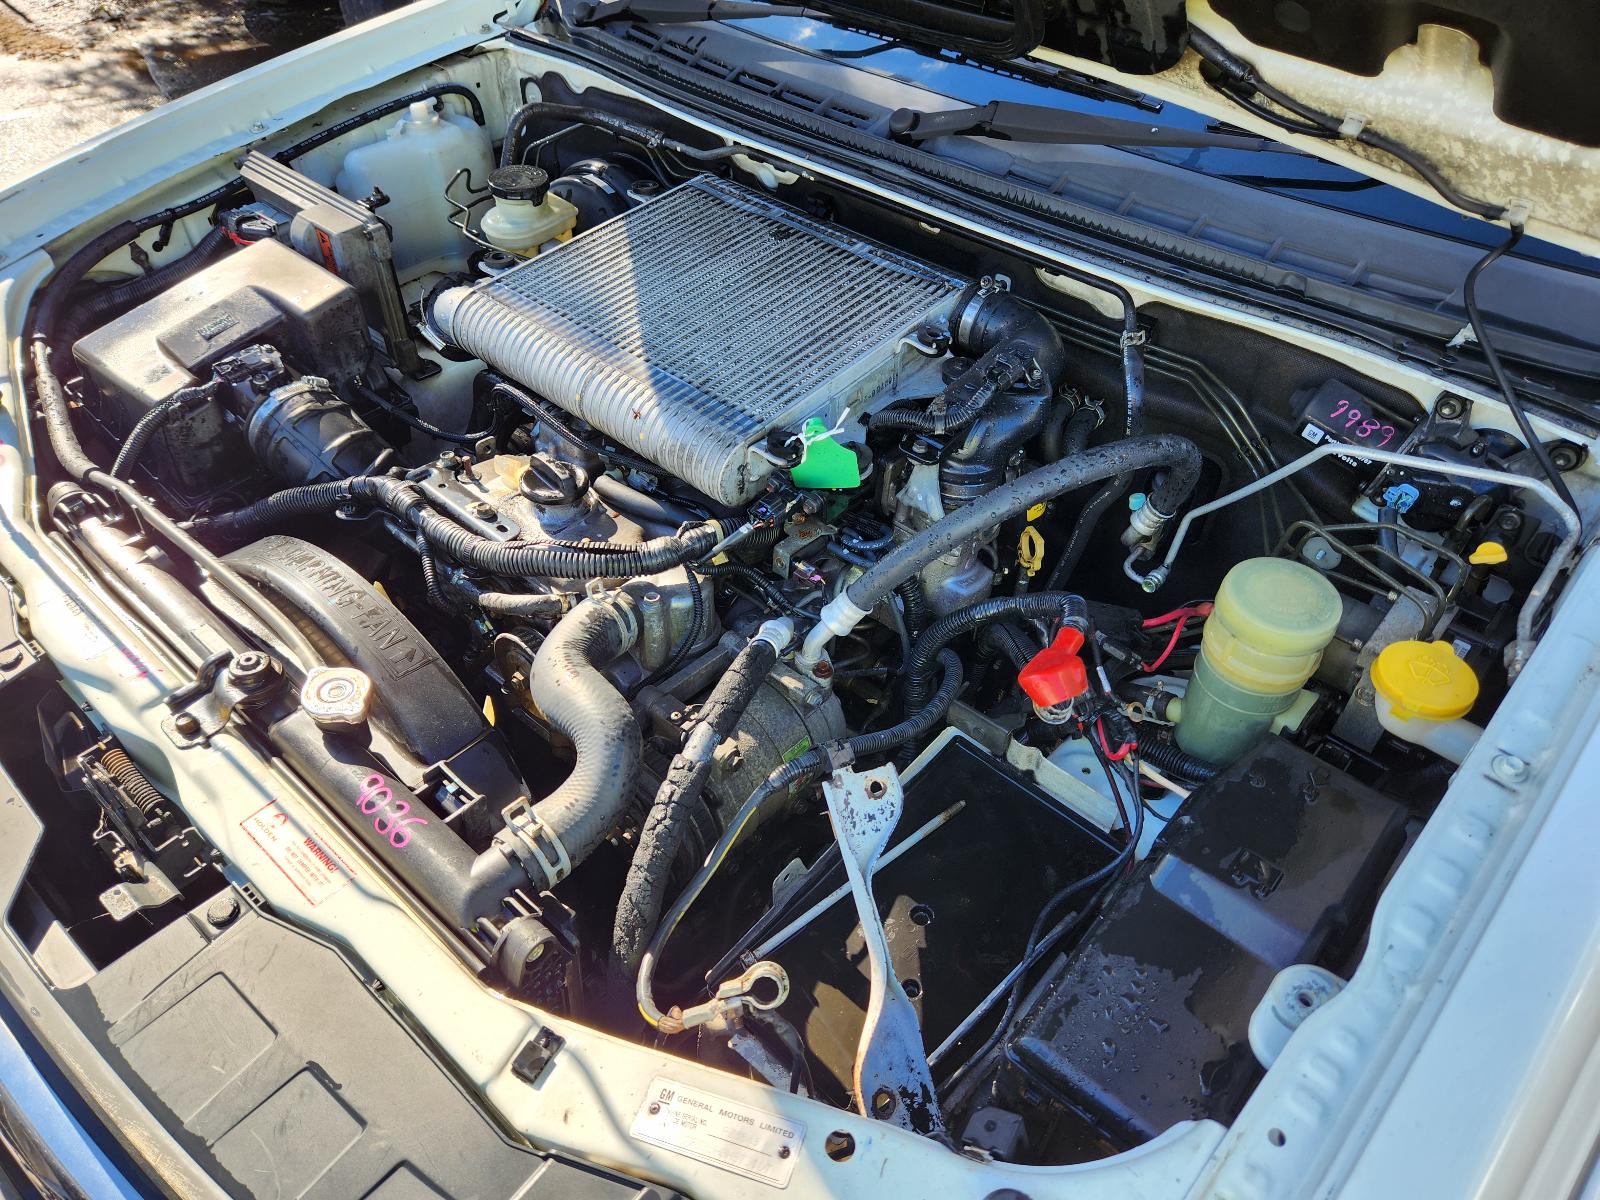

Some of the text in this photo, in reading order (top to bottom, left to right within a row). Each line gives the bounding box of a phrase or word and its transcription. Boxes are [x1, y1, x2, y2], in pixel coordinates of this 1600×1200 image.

[253, 816, 277, 842] HOLDEN
[356, 773, 428, 848] 9036
[303, 836, 339, 873] WARNING!
[660, 1088, 795, 1140] GM GENERAL MOTORS LIMITED
